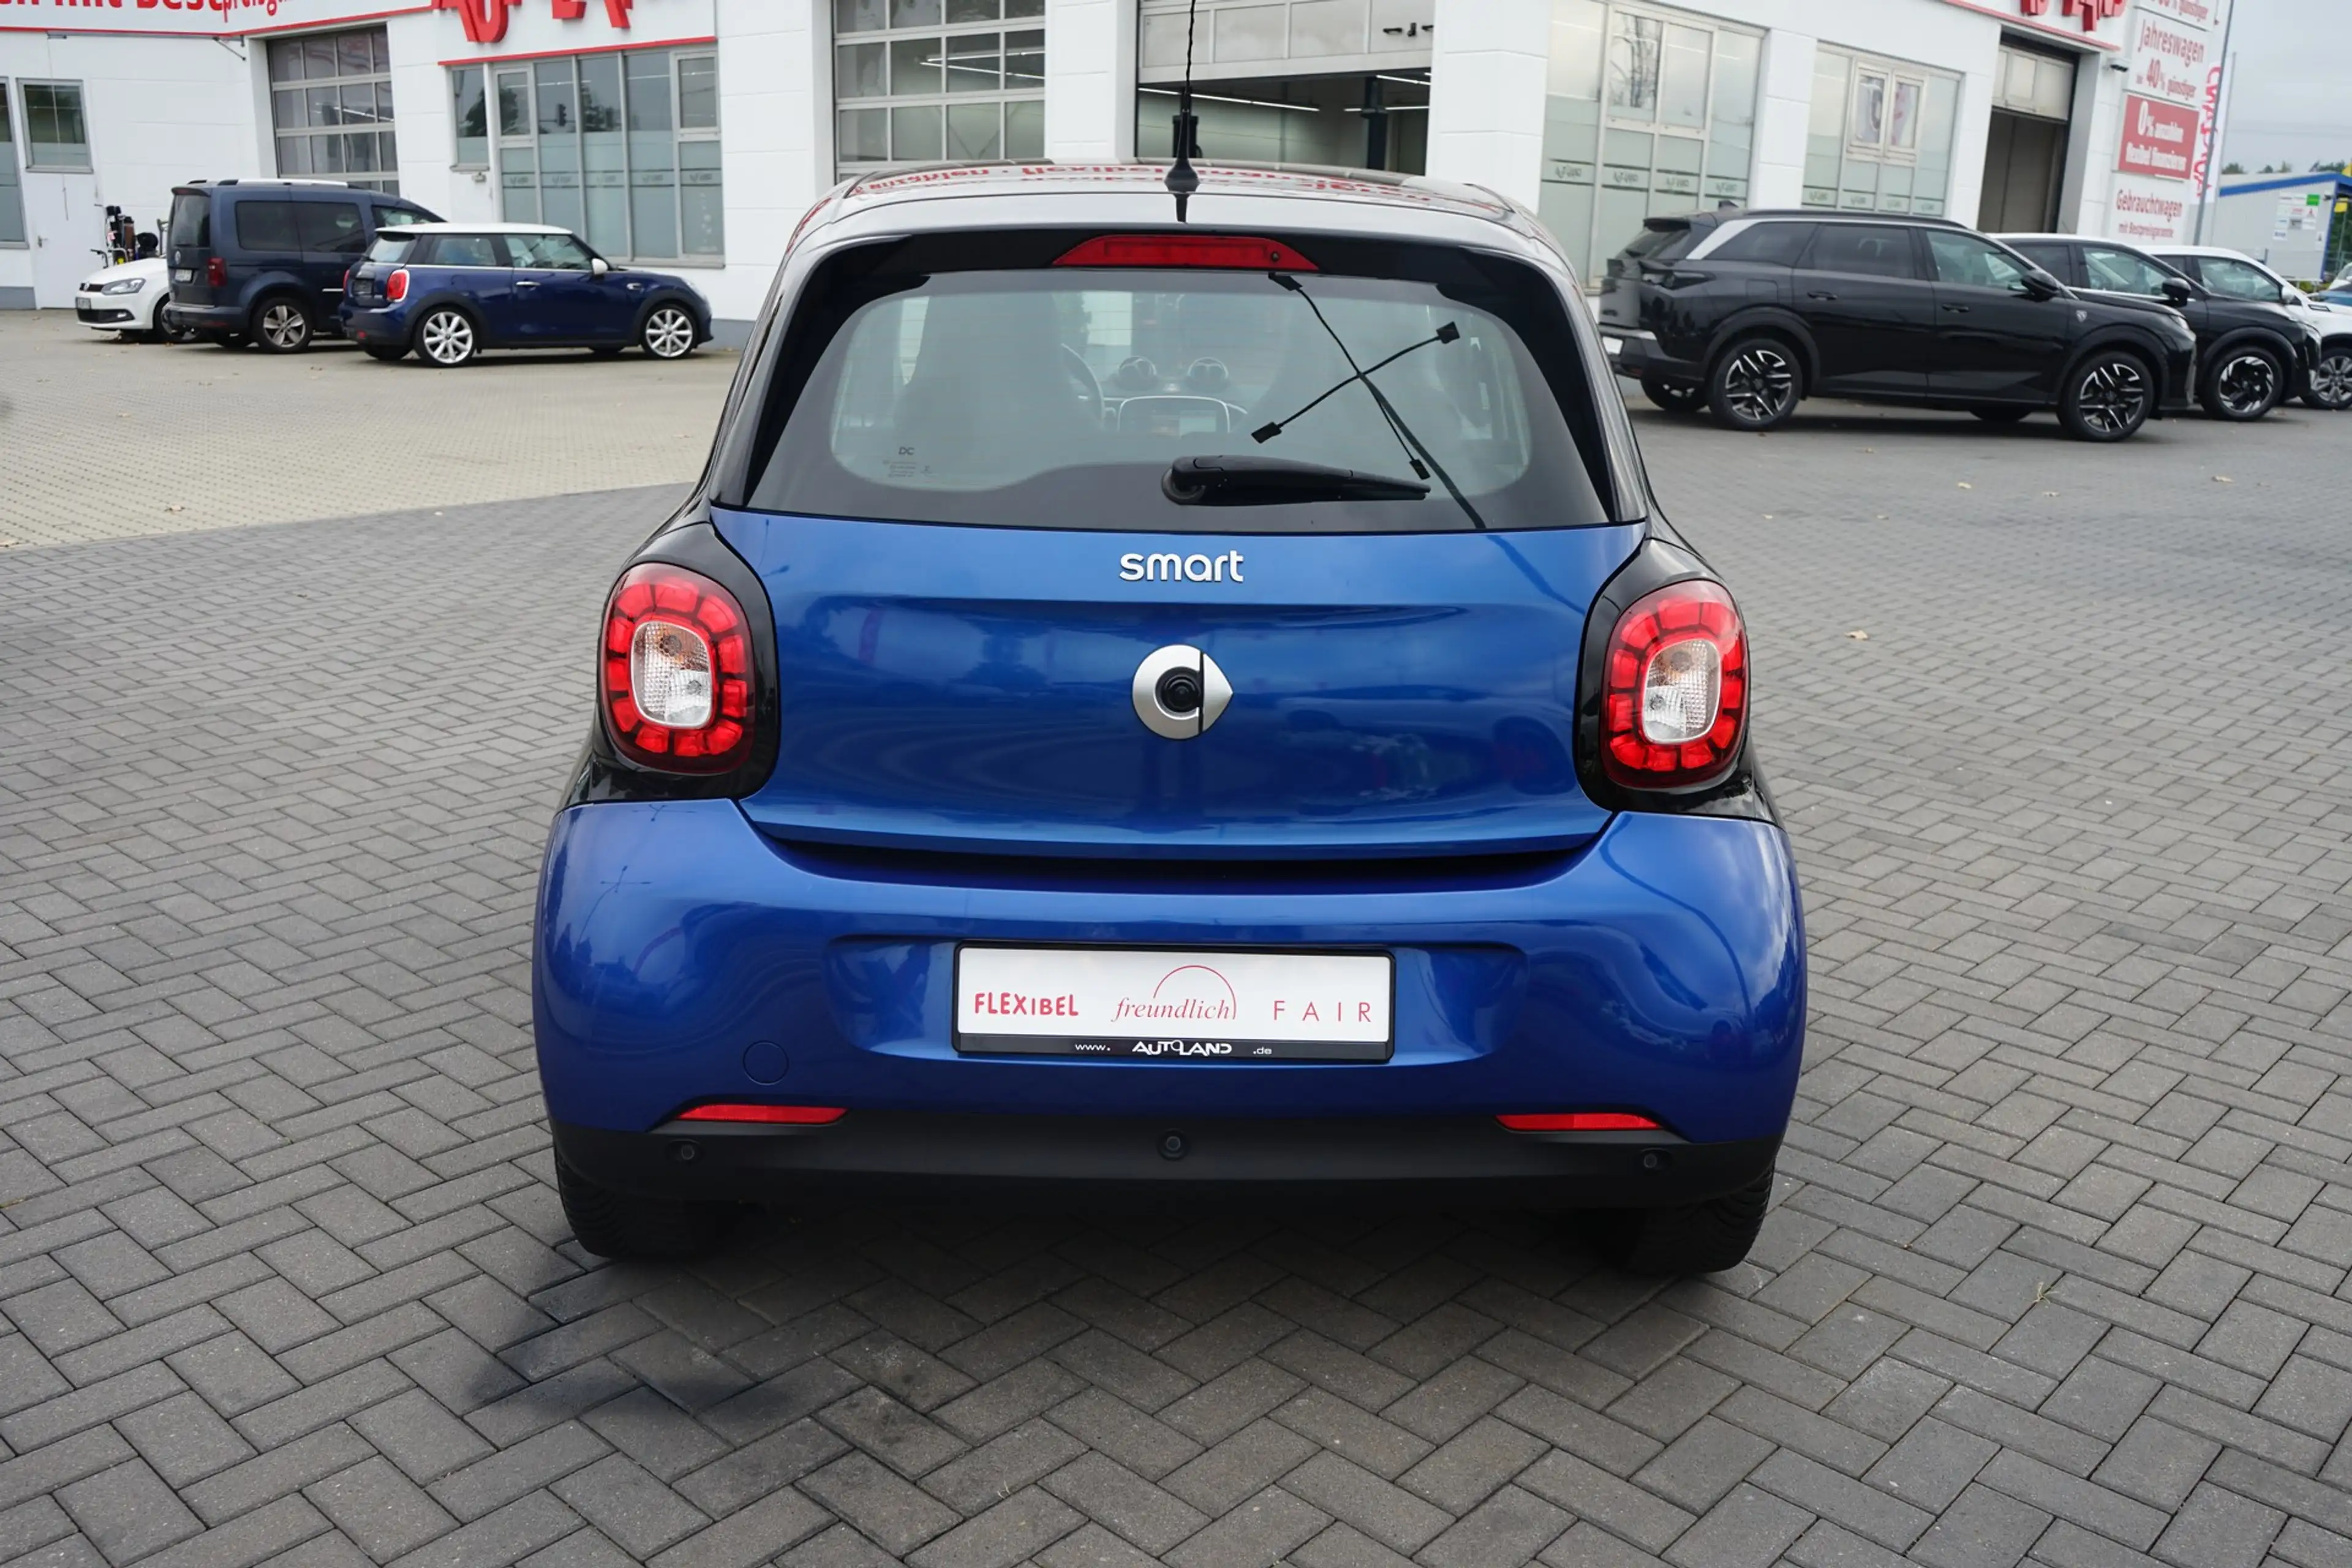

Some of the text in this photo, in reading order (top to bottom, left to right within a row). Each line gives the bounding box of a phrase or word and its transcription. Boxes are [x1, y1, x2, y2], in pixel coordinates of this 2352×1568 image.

[2138, 19, 2204, 67] Jahreswagen
[2117, 189, 2183, 222] Gebrauchtwagen
[1119, 550, 1244, 583] smart
[975, 992, 1371, 1022] FLEXIBEL freundlich FAIR
[1132, 1039, 1232, 1057] AUTOLAND
[1253, 1046, 1272, 1055] .de
